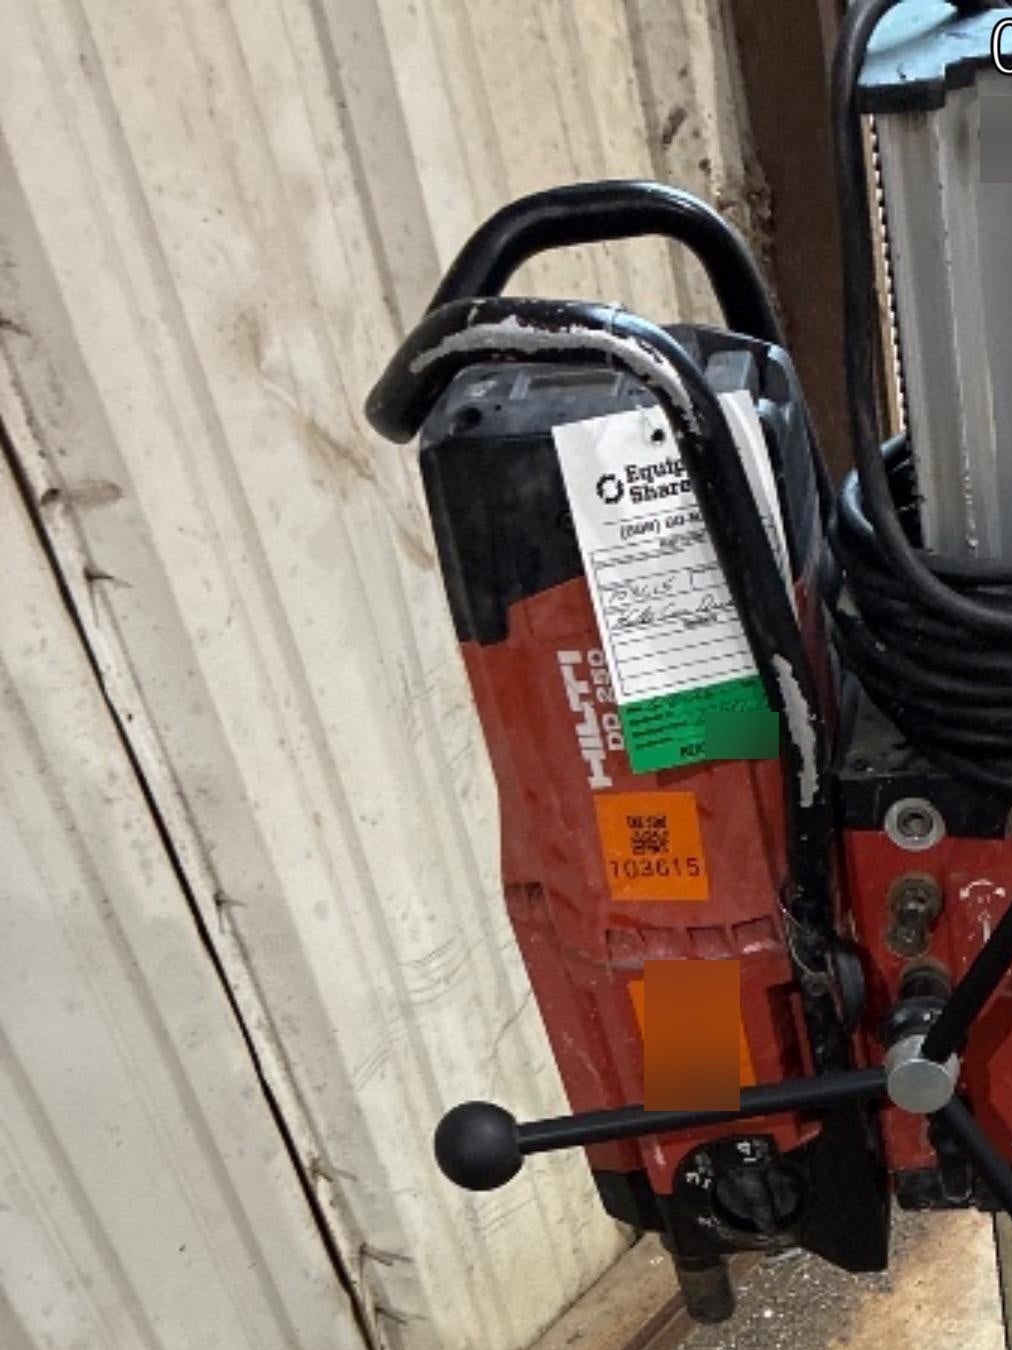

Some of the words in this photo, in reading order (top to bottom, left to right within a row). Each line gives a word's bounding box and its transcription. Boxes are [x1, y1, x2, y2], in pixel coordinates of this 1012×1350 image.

[629, 480, 691, 504] Share
[556, 650, 613, 789] HILTI
[602, 713, 626, 751] DD
